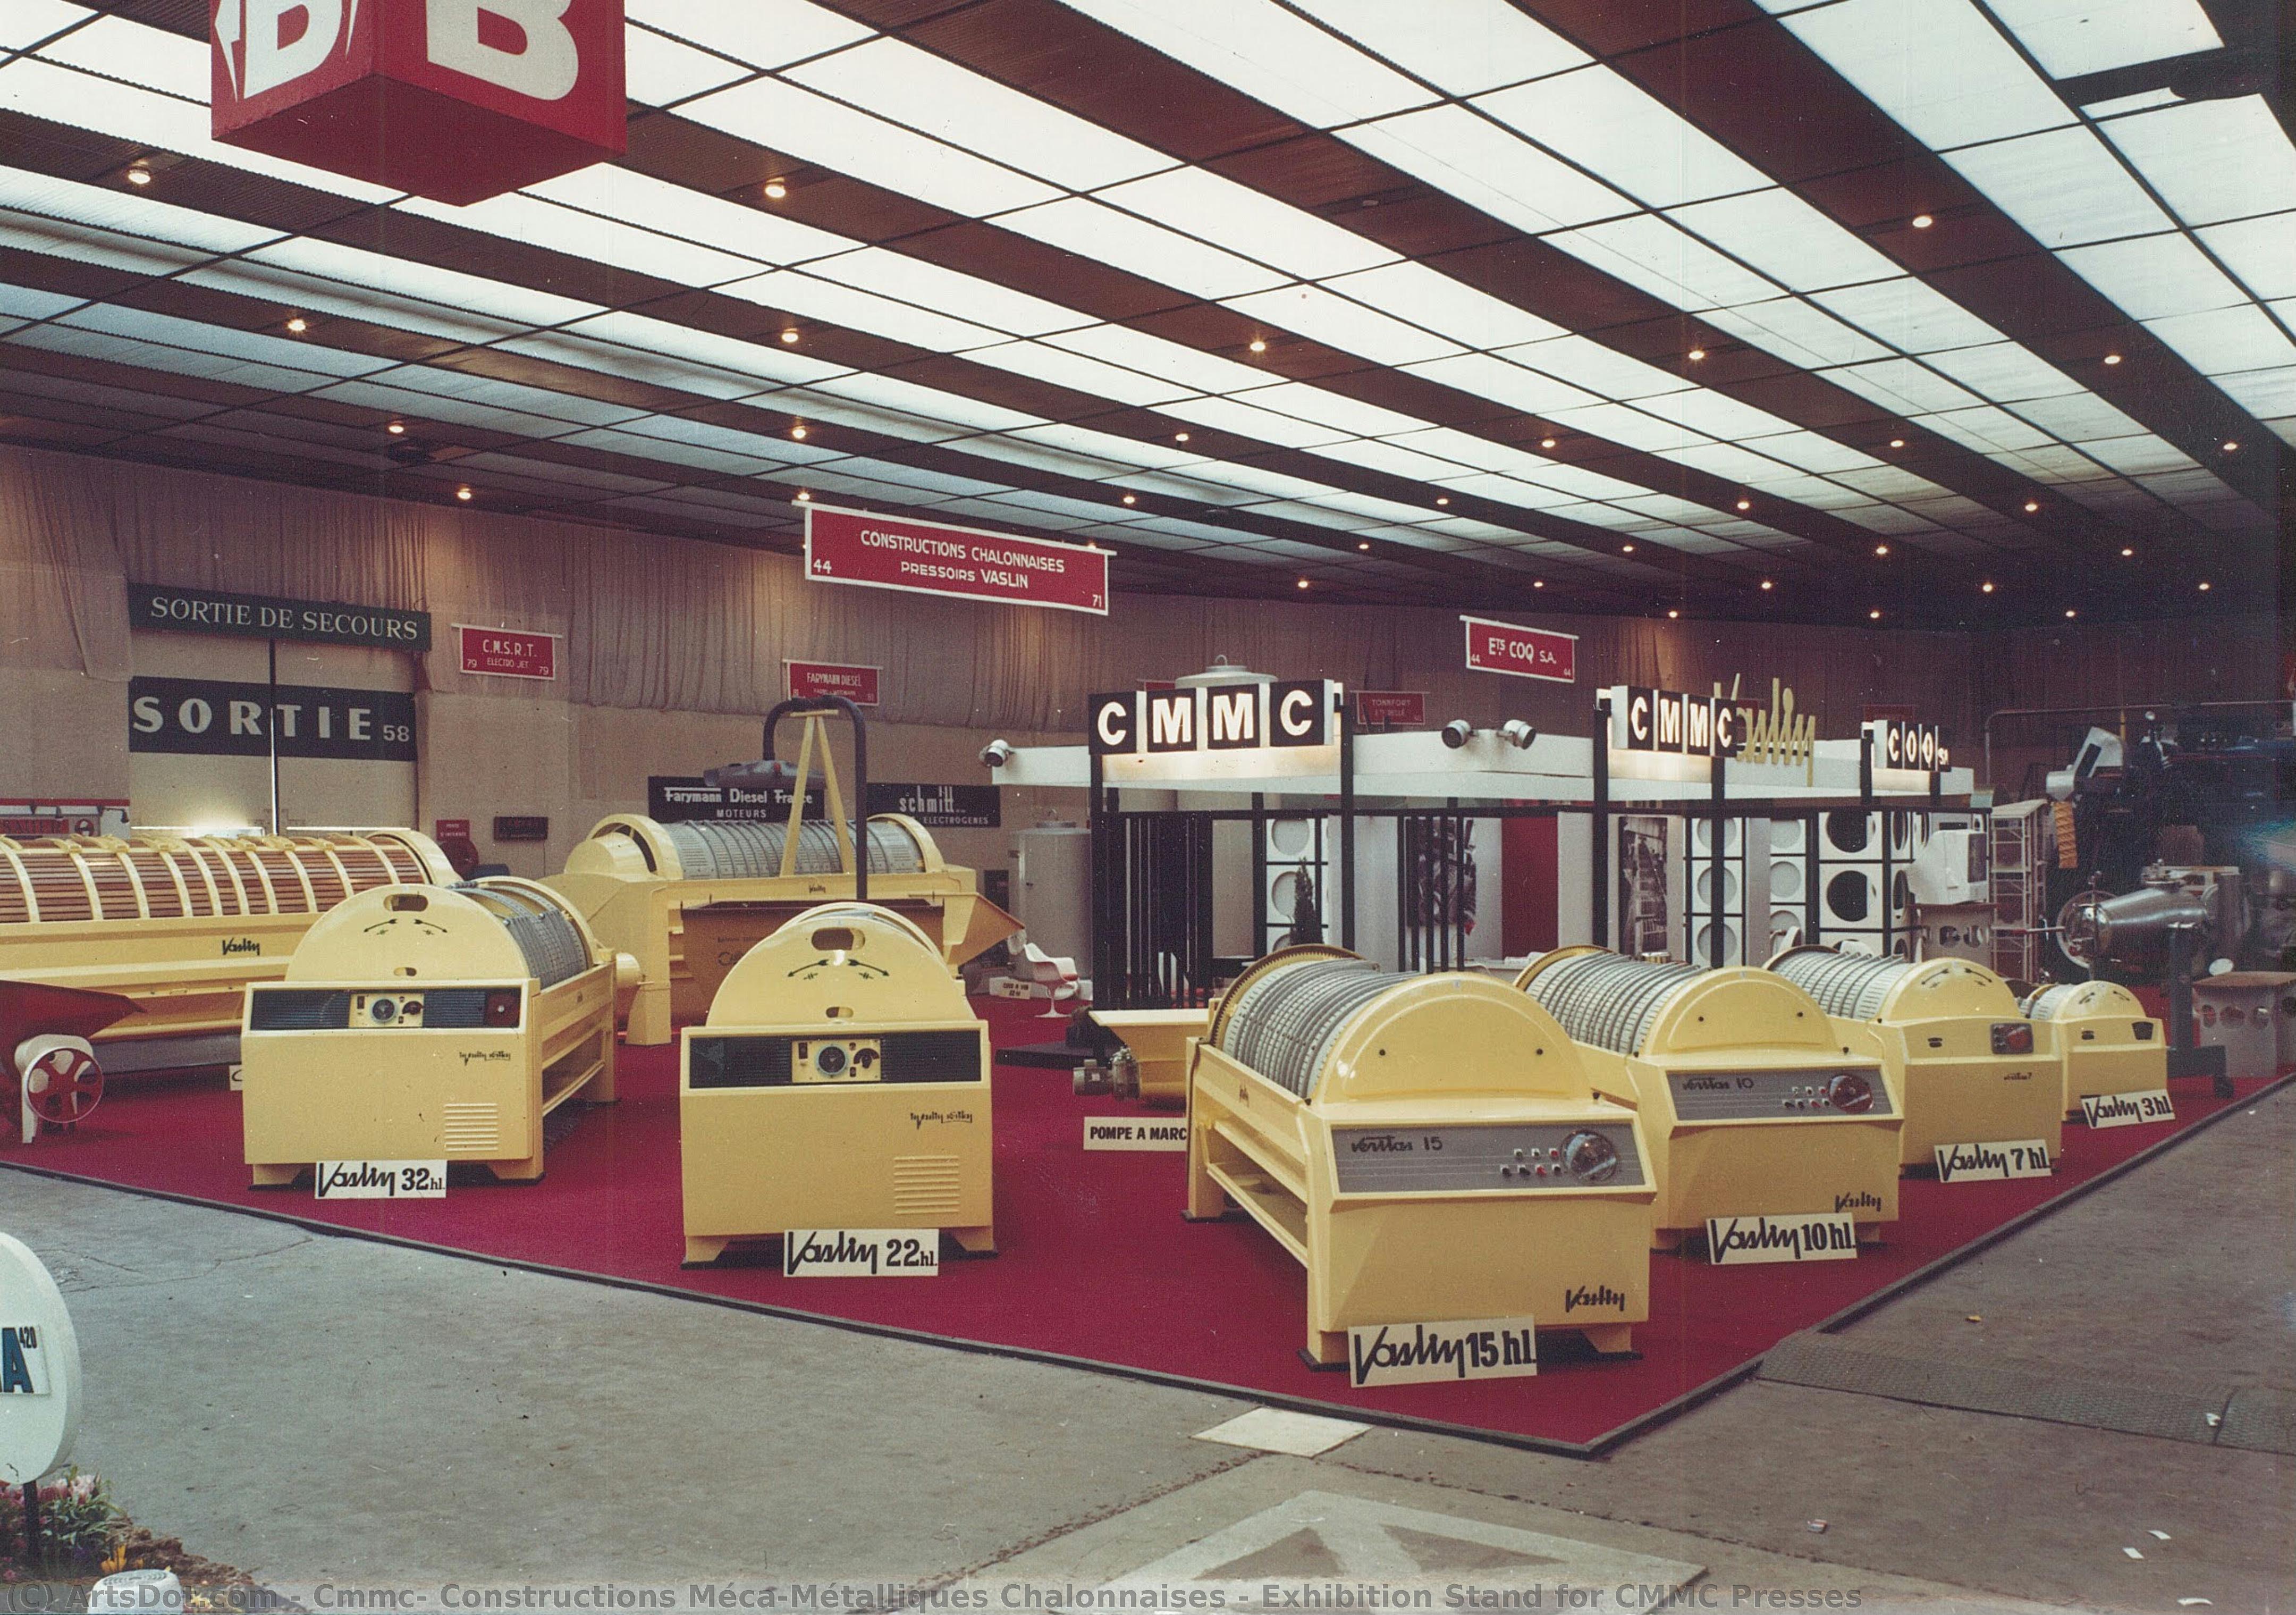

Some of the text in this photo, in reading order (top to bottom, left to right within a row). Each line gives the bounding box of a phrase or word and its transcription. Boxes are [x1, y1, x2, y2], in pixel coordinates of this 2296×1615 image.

[813, 559, 832, 574] 44
[861, 530, 1065, 573] CONSTRUCTIONS CHALONNAISES
[901, 561, 1029, 589] PRESSOIRS VASLIN
[1092, 594, 1102, 607] 71
[151, 596, 418, 640] SORTIE DE SECOURS
[467, 659, 477, 668] 79
[1509, 641, 1534, 664] COQ
[538, 666, 549, 675] 79
[133, 696, 410, 743] SORTIE 58
[1098, 689, 1313, 745] CMMC
[1631, 696, 1733, 748] CMMC
[1888, 728, 1933, 768] COQ
[664, 787, 722, 803] Farymann
[730, 788, 767, 803] Diesel
[899, 785, 954, 813] schmitt
[717, 809, 767, 818] MOTEURS
[2086, 1096, 2143, 1128] Vaslin
[1090, 1126, 1132, 1141] POMPE
[1137, 1126, 1145, 1140] A
[1423, 1135, 1442, 1151] 15
[1938, 1144, 2009, 1182] Vaslin
[319, 1162, 395, 1198] Vaslin
[788, 1231, 877, 1275] Vaslin
[1710, 1217, 1801, 1263] Vaslin
[1354, 1325, 1465, 1385] Vaslin
